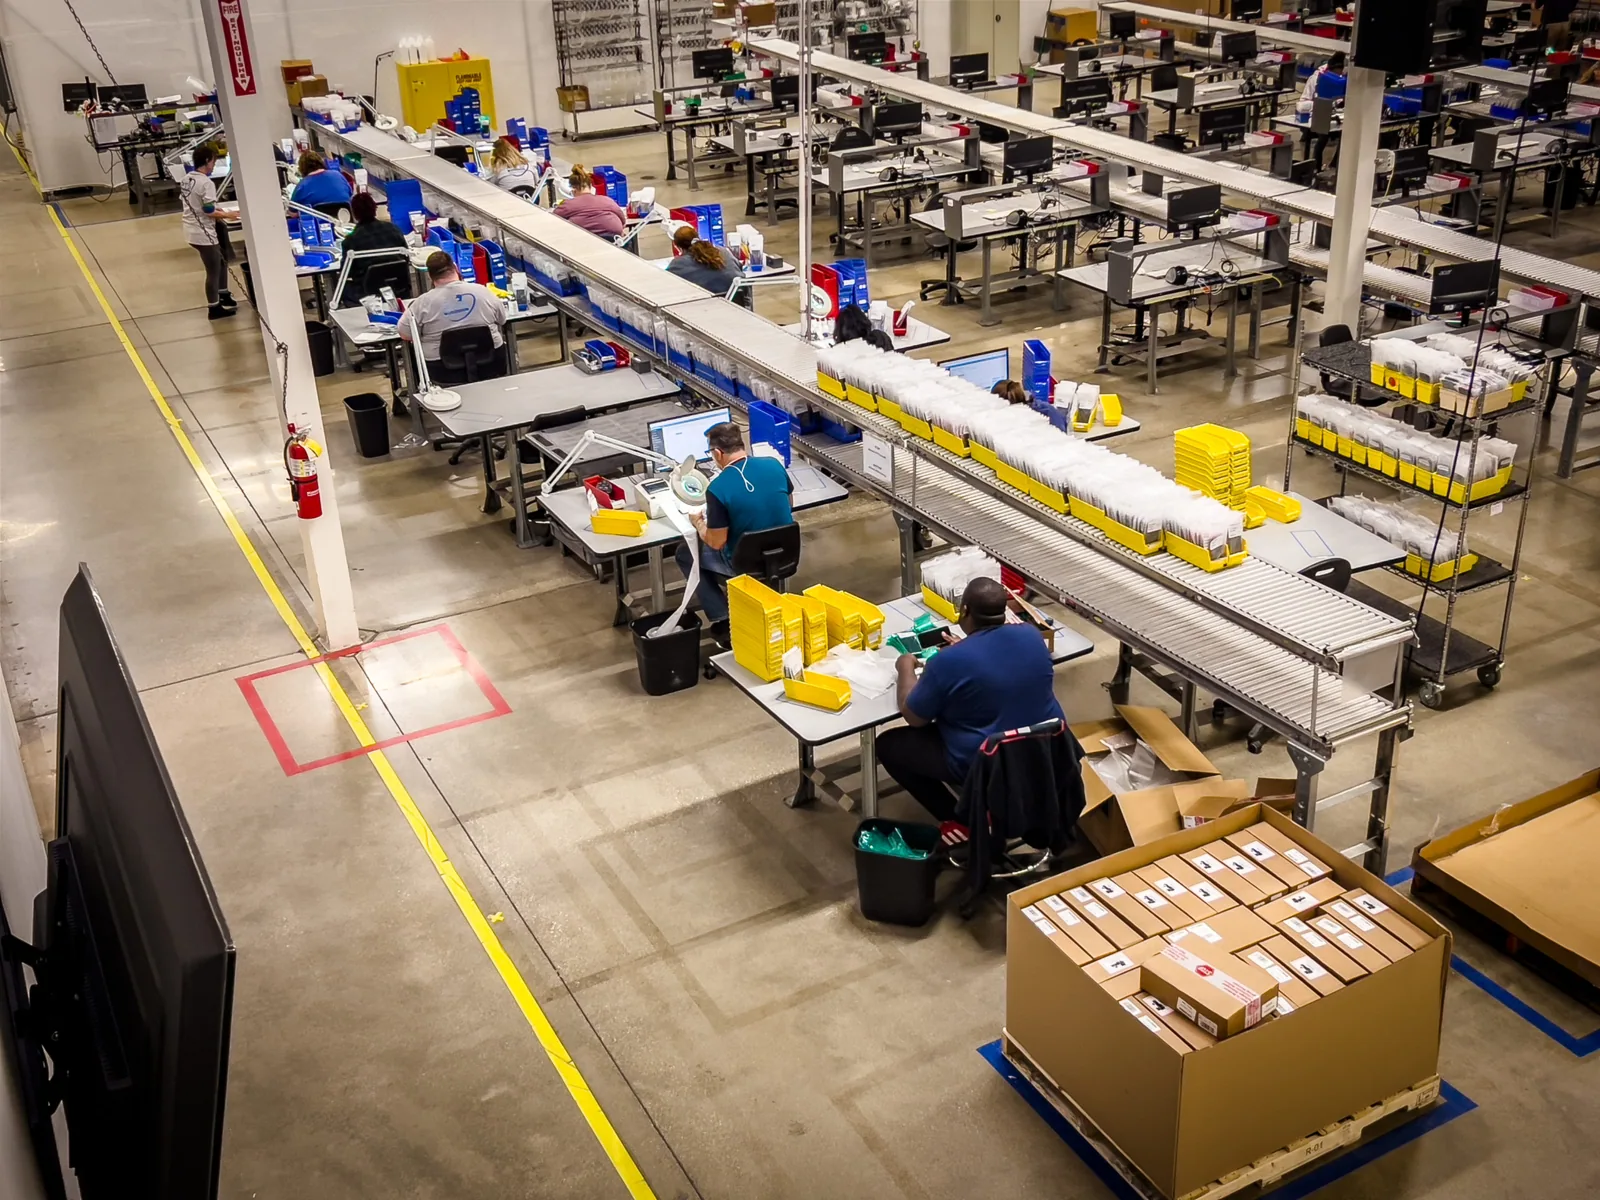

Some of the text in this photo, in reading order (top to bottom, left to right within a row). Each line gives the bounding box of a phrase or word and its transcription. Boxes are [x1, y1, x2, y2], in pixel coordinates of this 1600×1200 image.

[222, 5, 239, 14] FIRE
[230, 17, 247, 84] EXTINGUISHER
[455, 72, 482, 80] FLAMMABLE
[1305, 1141, 1324, 1156] R-01
